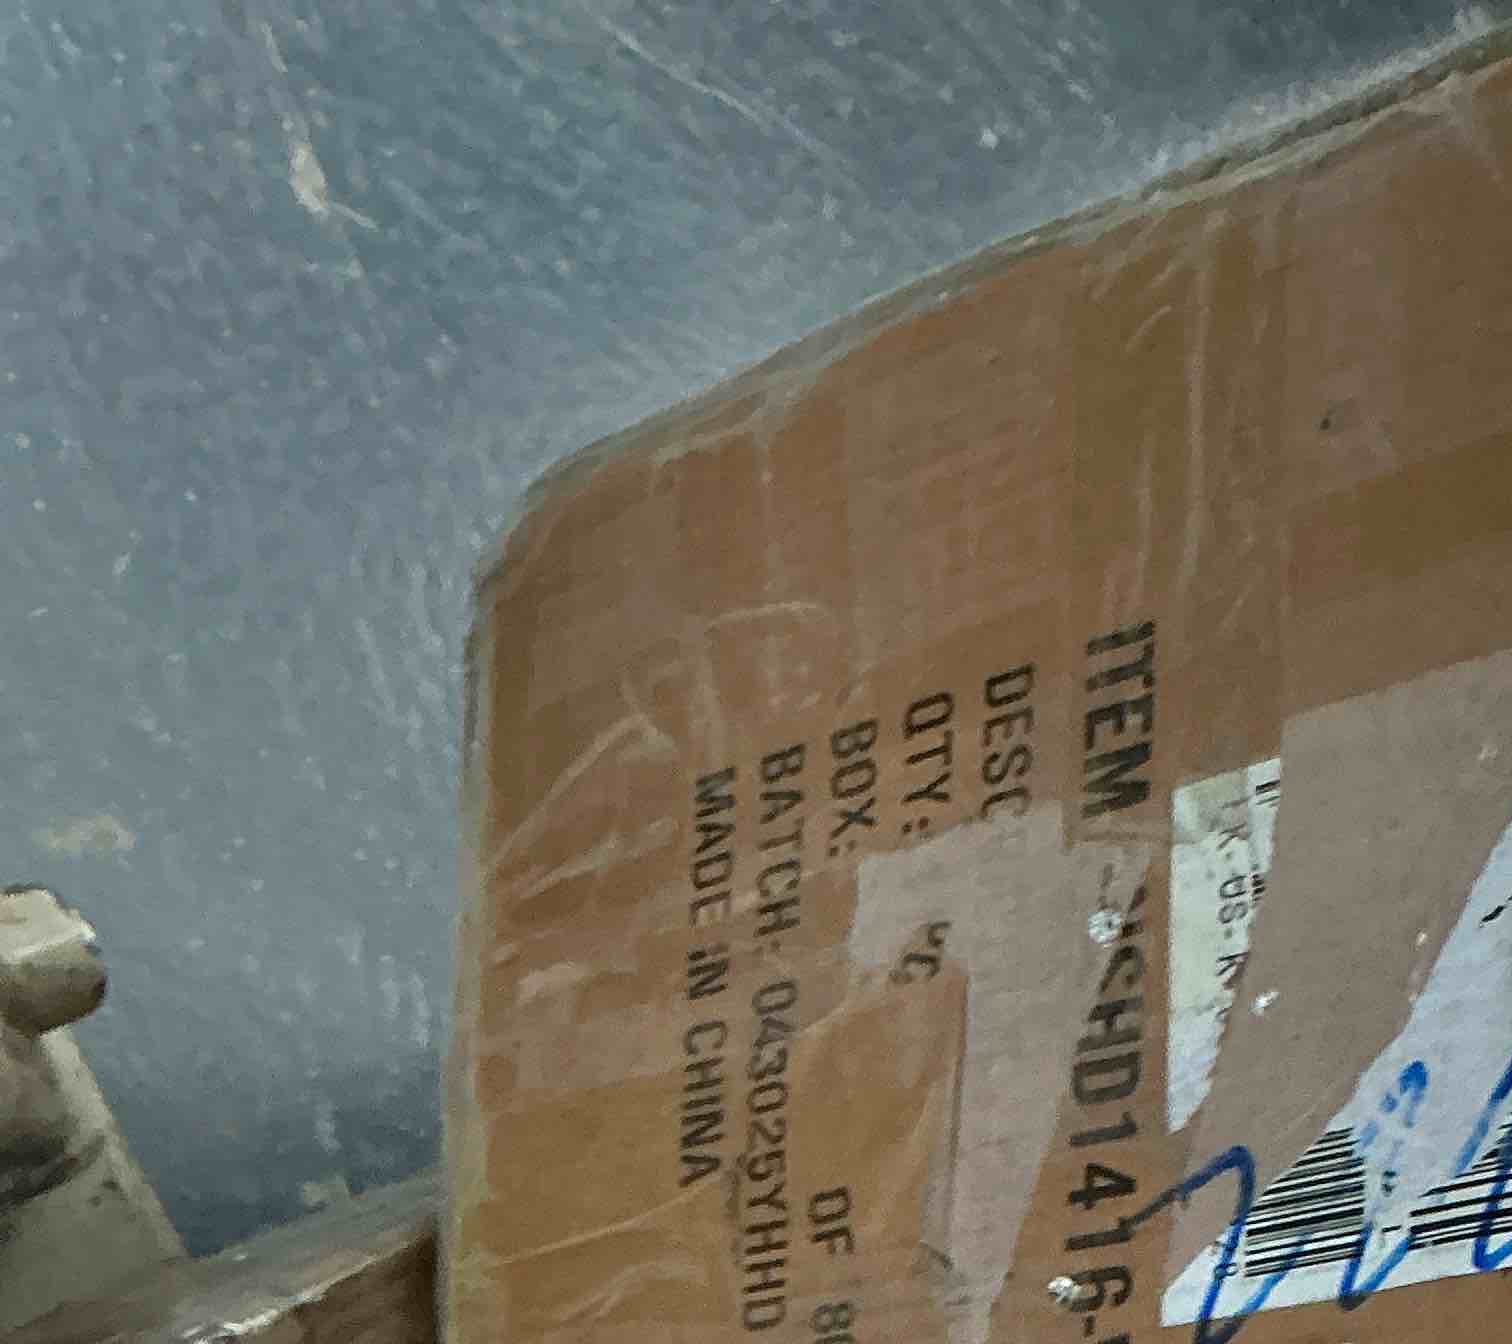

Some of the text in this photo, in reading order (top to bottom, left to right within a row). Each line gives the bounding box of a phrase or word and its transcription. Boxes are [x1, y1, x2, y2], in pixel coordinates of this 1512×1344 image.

[826, 716, 880, 858] BOX:
[1081, 619, 1156, 820] ITEM
[755, 742, 807, 957] BATCH:
[678, 766, 738, 1189] MADE IN CHINA
[806, 1184, 854, 1256] OF
